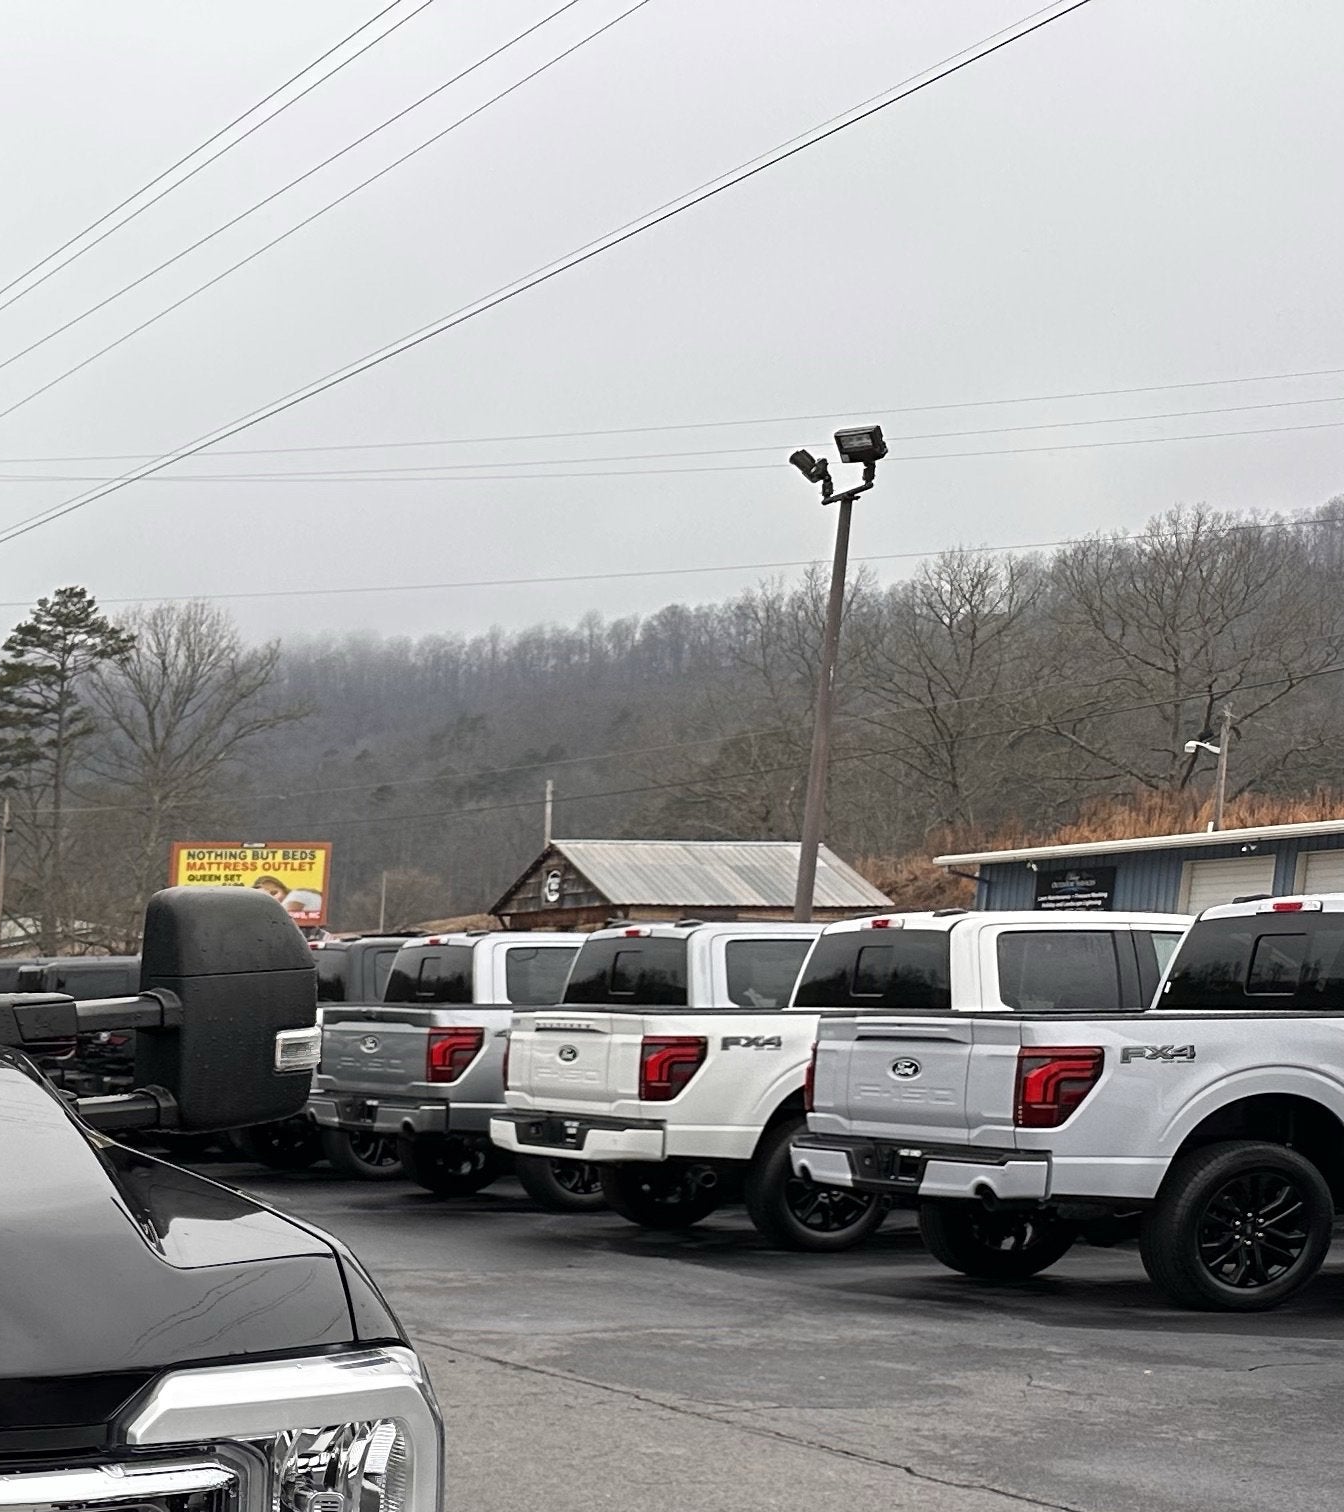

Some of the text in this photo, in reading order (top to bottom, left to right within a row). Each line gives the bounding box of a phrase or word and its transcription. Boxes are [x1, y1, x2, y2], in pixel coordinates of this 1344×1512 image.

[186, 850, 317, 861] NOTHING BUT BEDS
[186, 861, 316, 872] MATTRESS OUTLET
[187, 873, 242, 883] QUEEN SET
[720, 1035, 783, 1051] FX4
[1120, 1045, 1196, 1064] FX4
